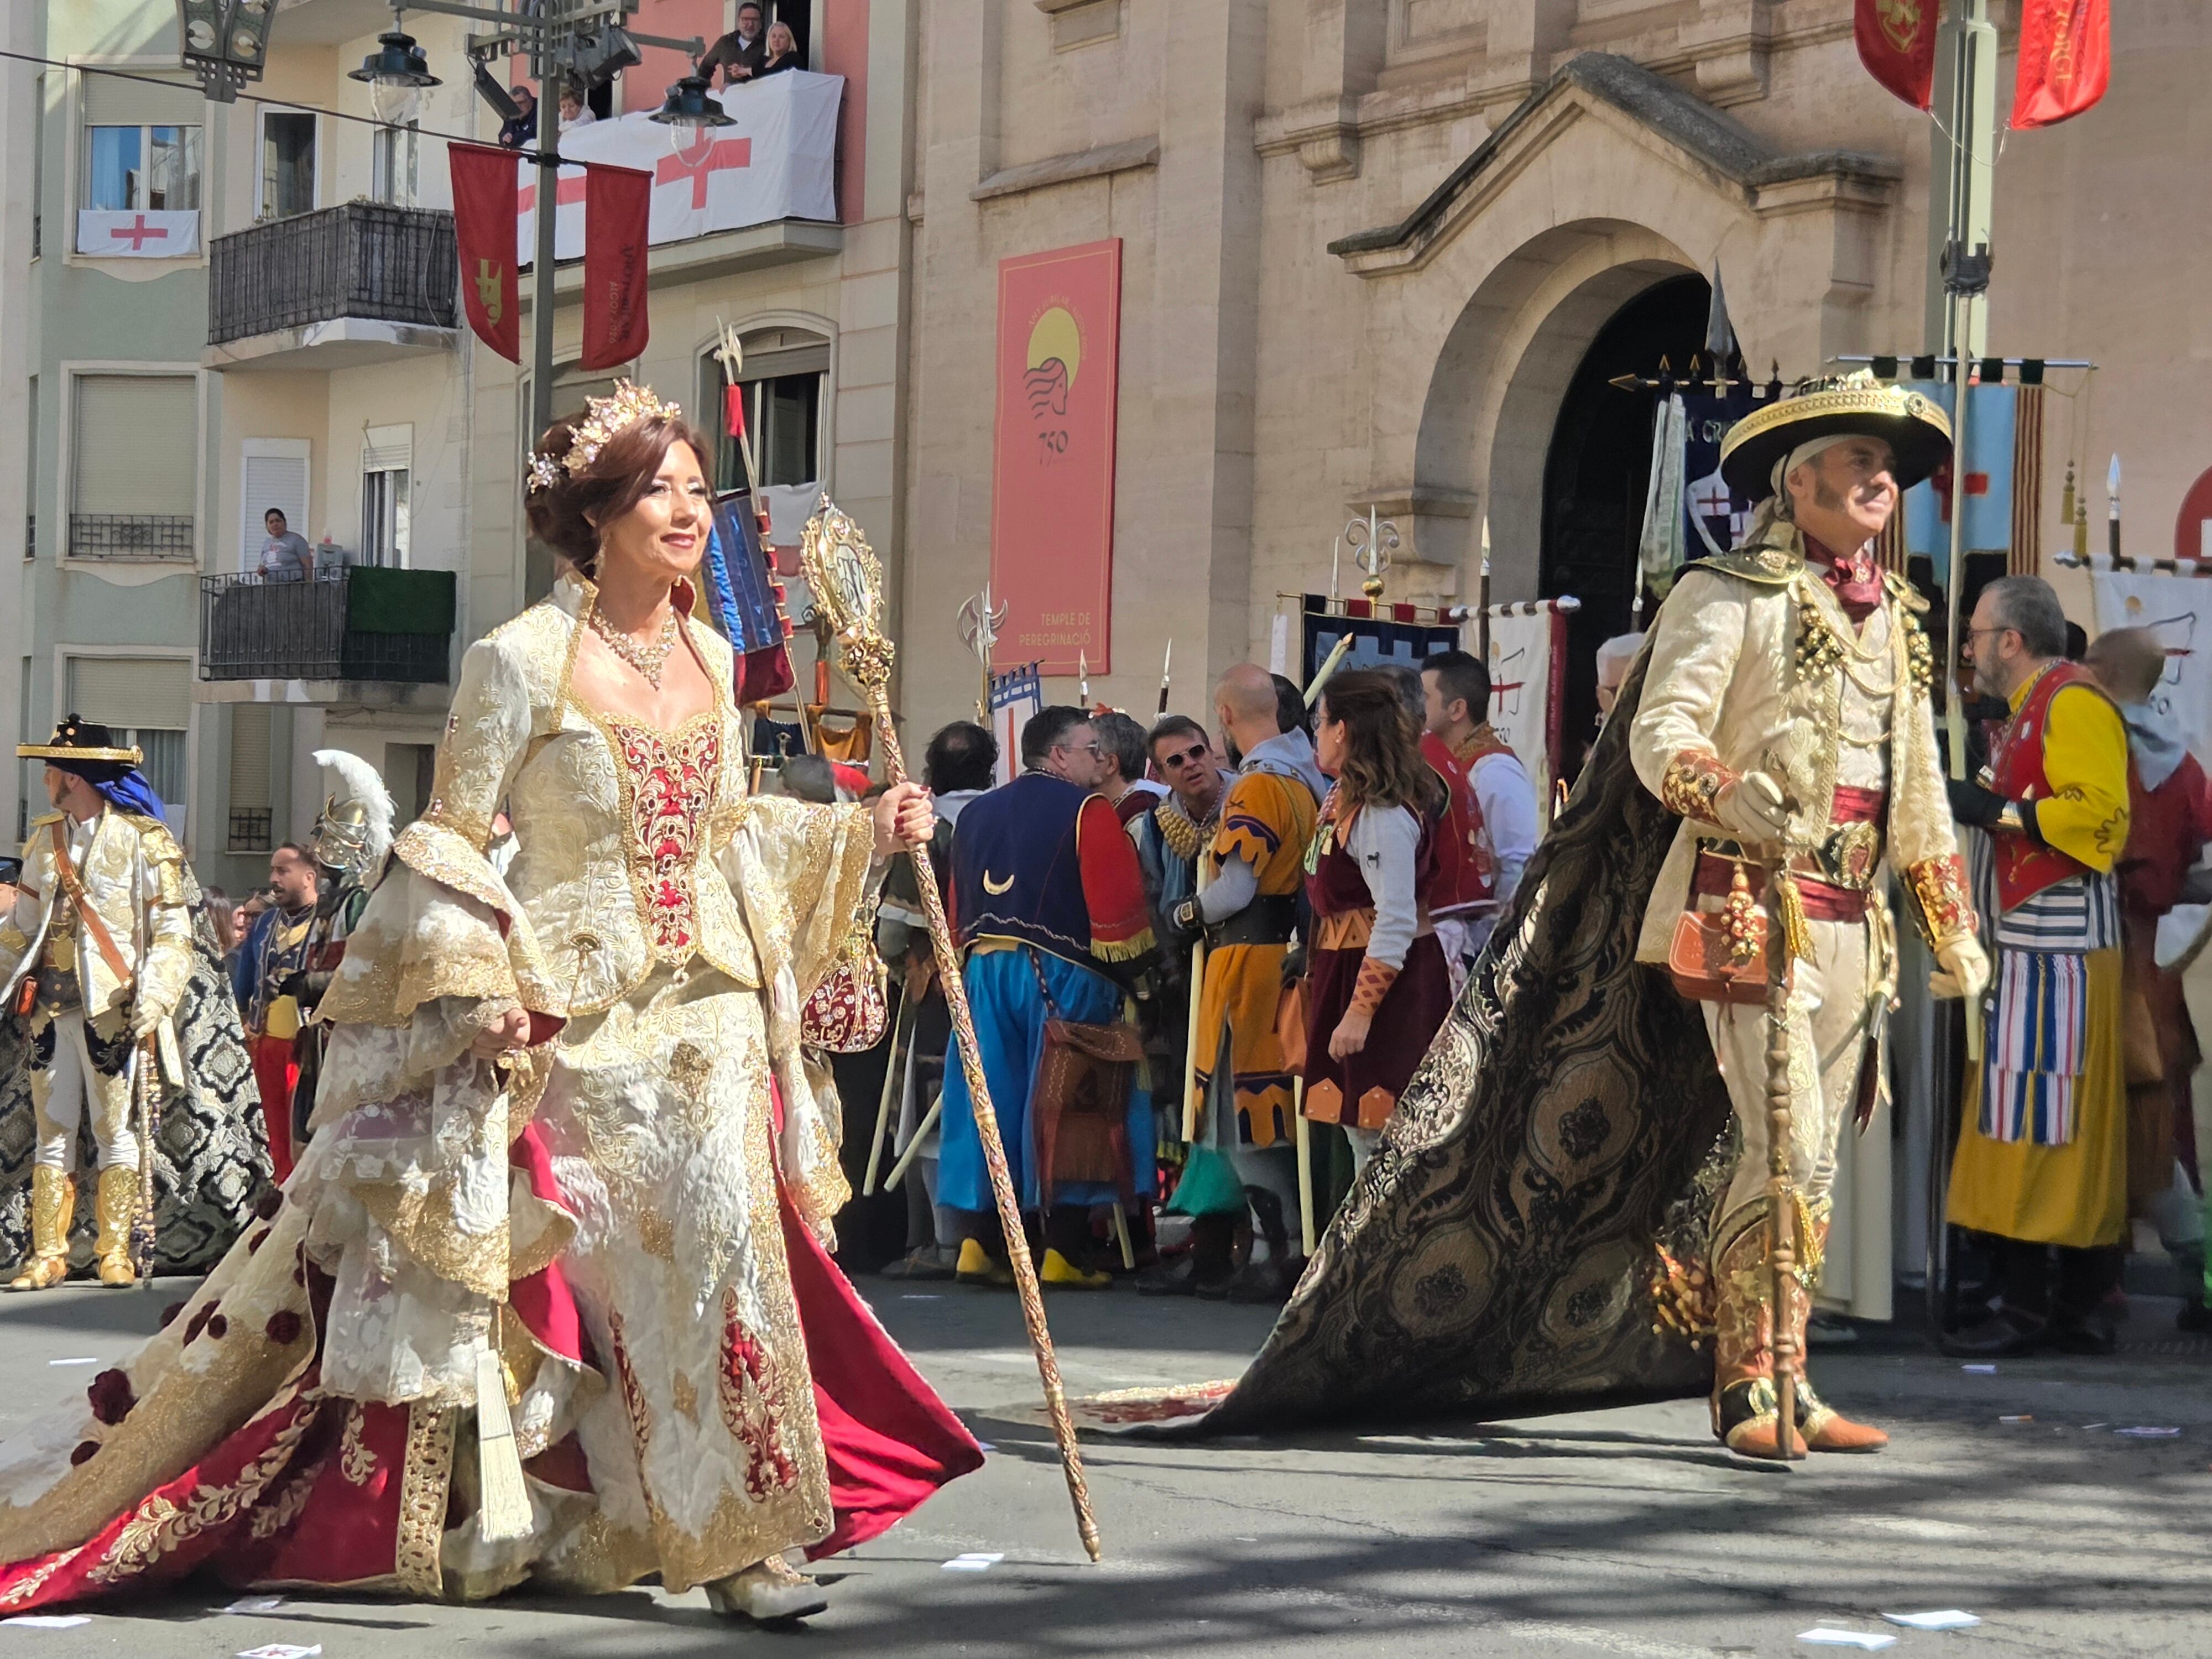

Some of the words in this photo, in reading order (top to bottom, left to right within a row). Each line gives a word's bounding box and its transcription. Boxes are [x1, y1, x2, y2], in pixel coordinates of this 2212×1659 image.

[609, 281, 619, 314] ALCOY
[609, 316, 618, 344] 2026
[1038, 430, 1068, 468] 750
[1040, 612, 1076, 627] TEMPLE
[1078, 612, 1091, 625] DE
[1019, 628, 1091, 646] PEREGRINACIÓ
